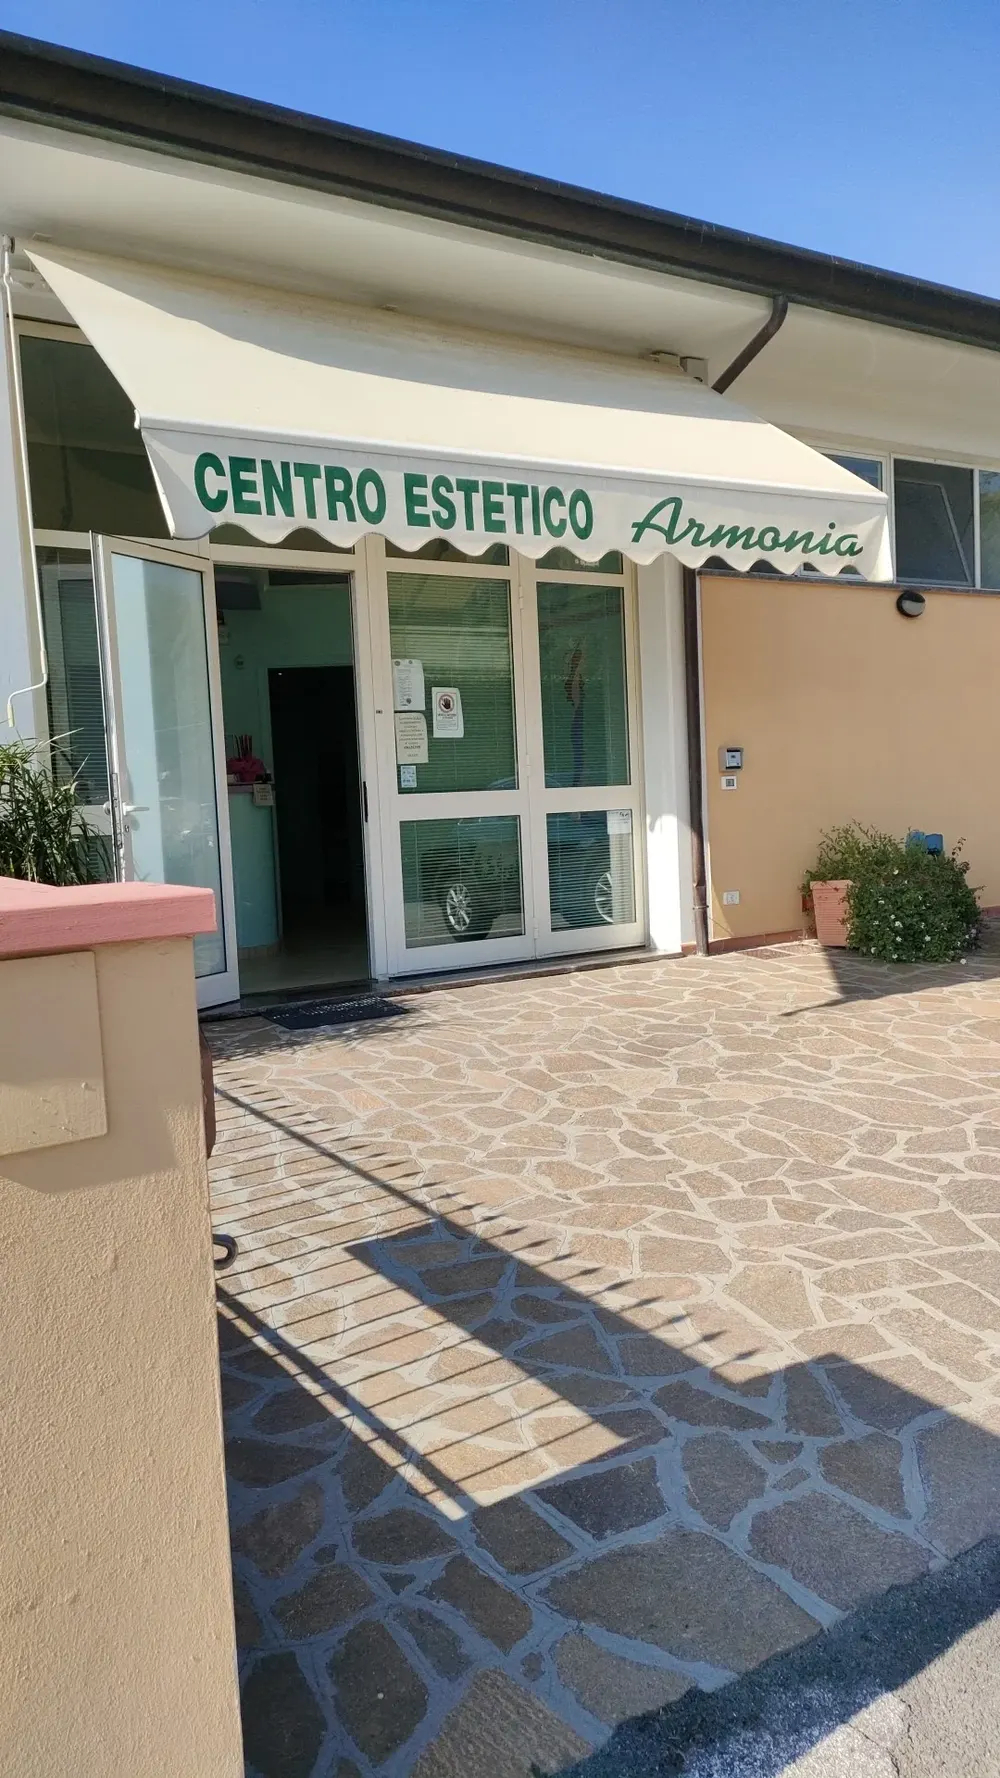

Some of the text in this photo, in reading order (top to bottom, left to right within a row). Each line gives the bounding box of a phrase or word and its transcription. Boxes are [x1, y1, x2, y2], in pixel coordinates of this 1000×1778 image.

[194, 452, 863, 556] CENTRO ESTETICO Armonia
